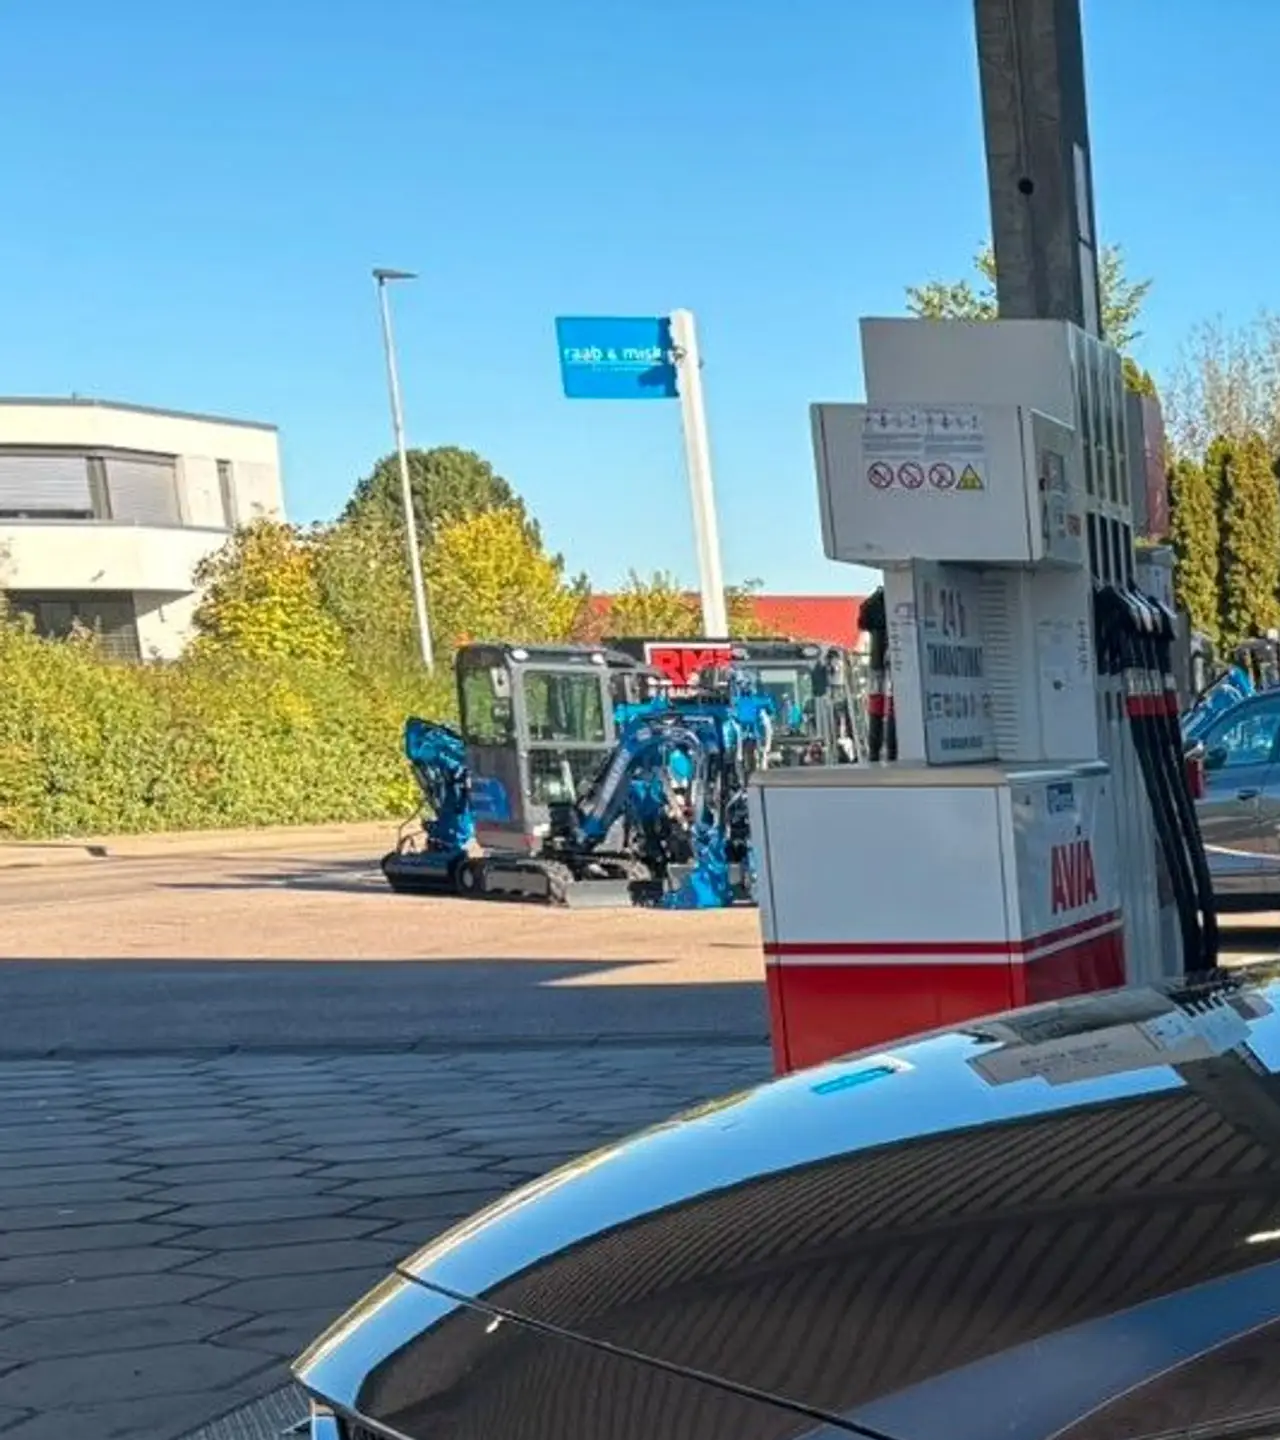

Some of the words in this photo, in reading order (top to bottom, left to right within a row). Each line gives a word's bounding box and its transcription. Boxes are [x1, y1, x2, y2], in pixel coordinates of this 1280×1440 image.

[563, 345, 603, 361] raab
[623, 345, 662, 361] misk
[1051, 839, 1098, 916] AVIA
